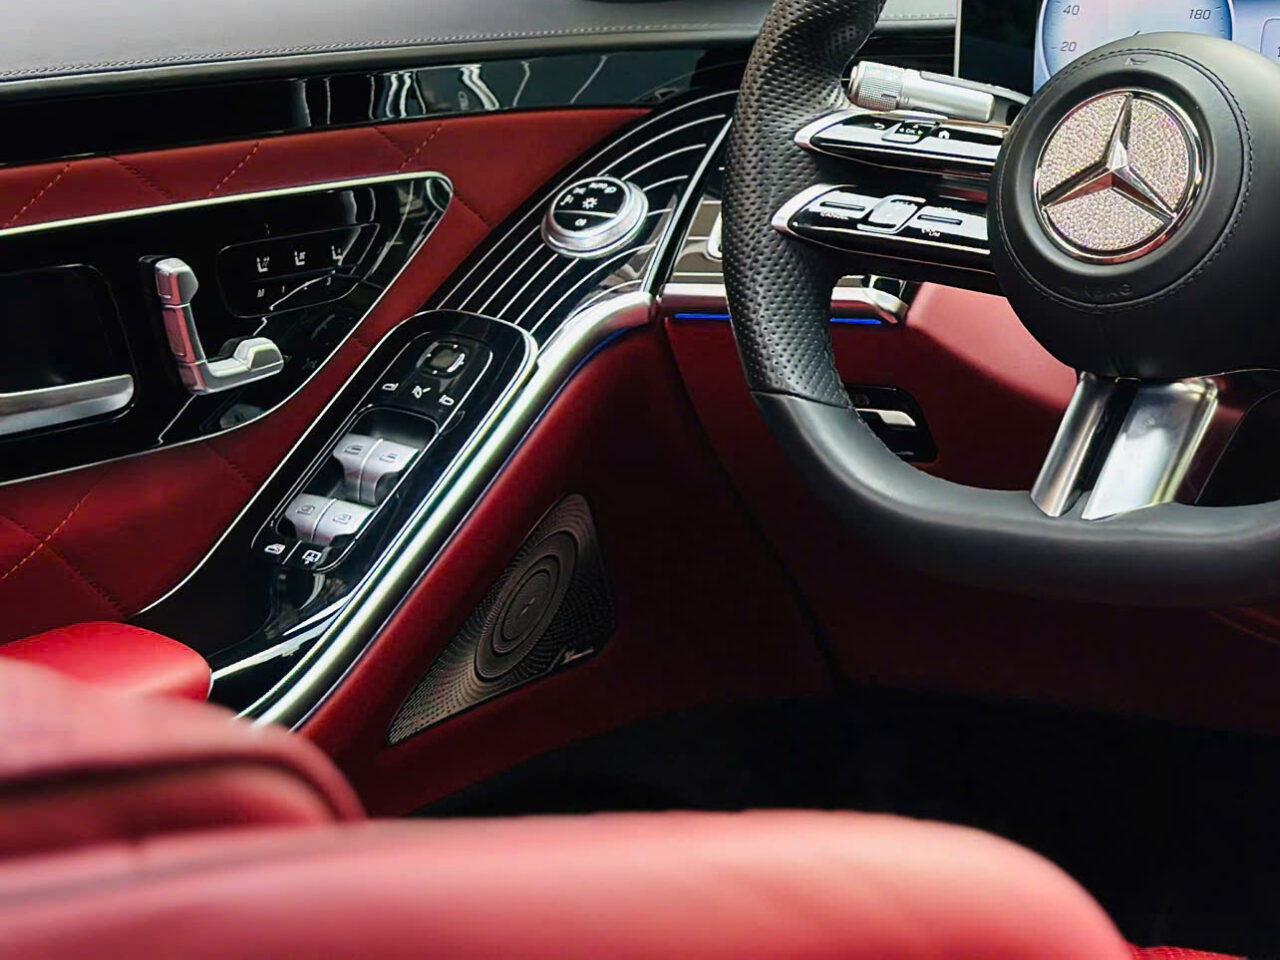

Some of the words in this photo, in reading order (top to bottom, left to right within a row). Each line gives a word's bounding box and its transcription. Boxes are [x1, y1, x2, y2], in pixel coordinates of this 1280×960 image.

[1062, 4, 1081, 16] 40
[1189, 8, 1212, 20] 180
[1060, 41, 1077, 52] 20
